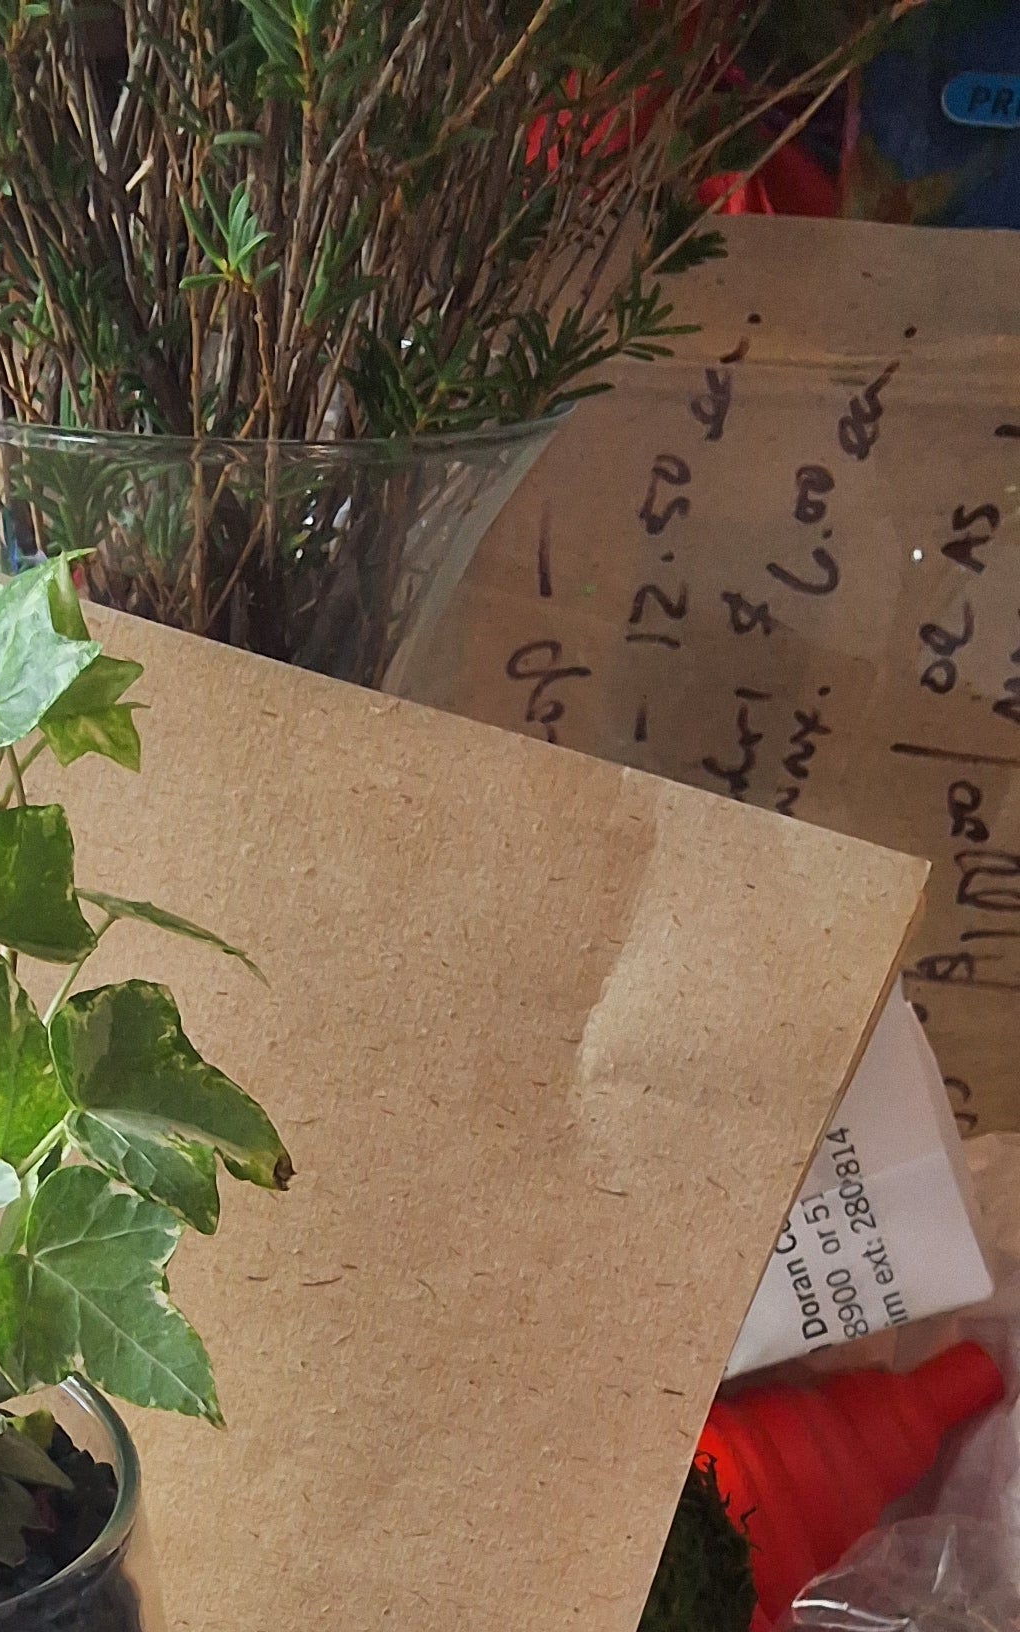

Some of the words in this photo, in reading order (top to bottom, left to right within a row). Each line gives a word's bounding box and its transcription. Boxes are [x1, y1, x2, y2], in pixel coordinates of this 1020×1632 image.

[967, 84, 1020, 117] PR
[816, 1229, 842, 1255] or
[860, 1236, 894, 1286] ext:
[786, 1257, 829, 1341] Doran
[825, 1268, 870, 1339] 8900
